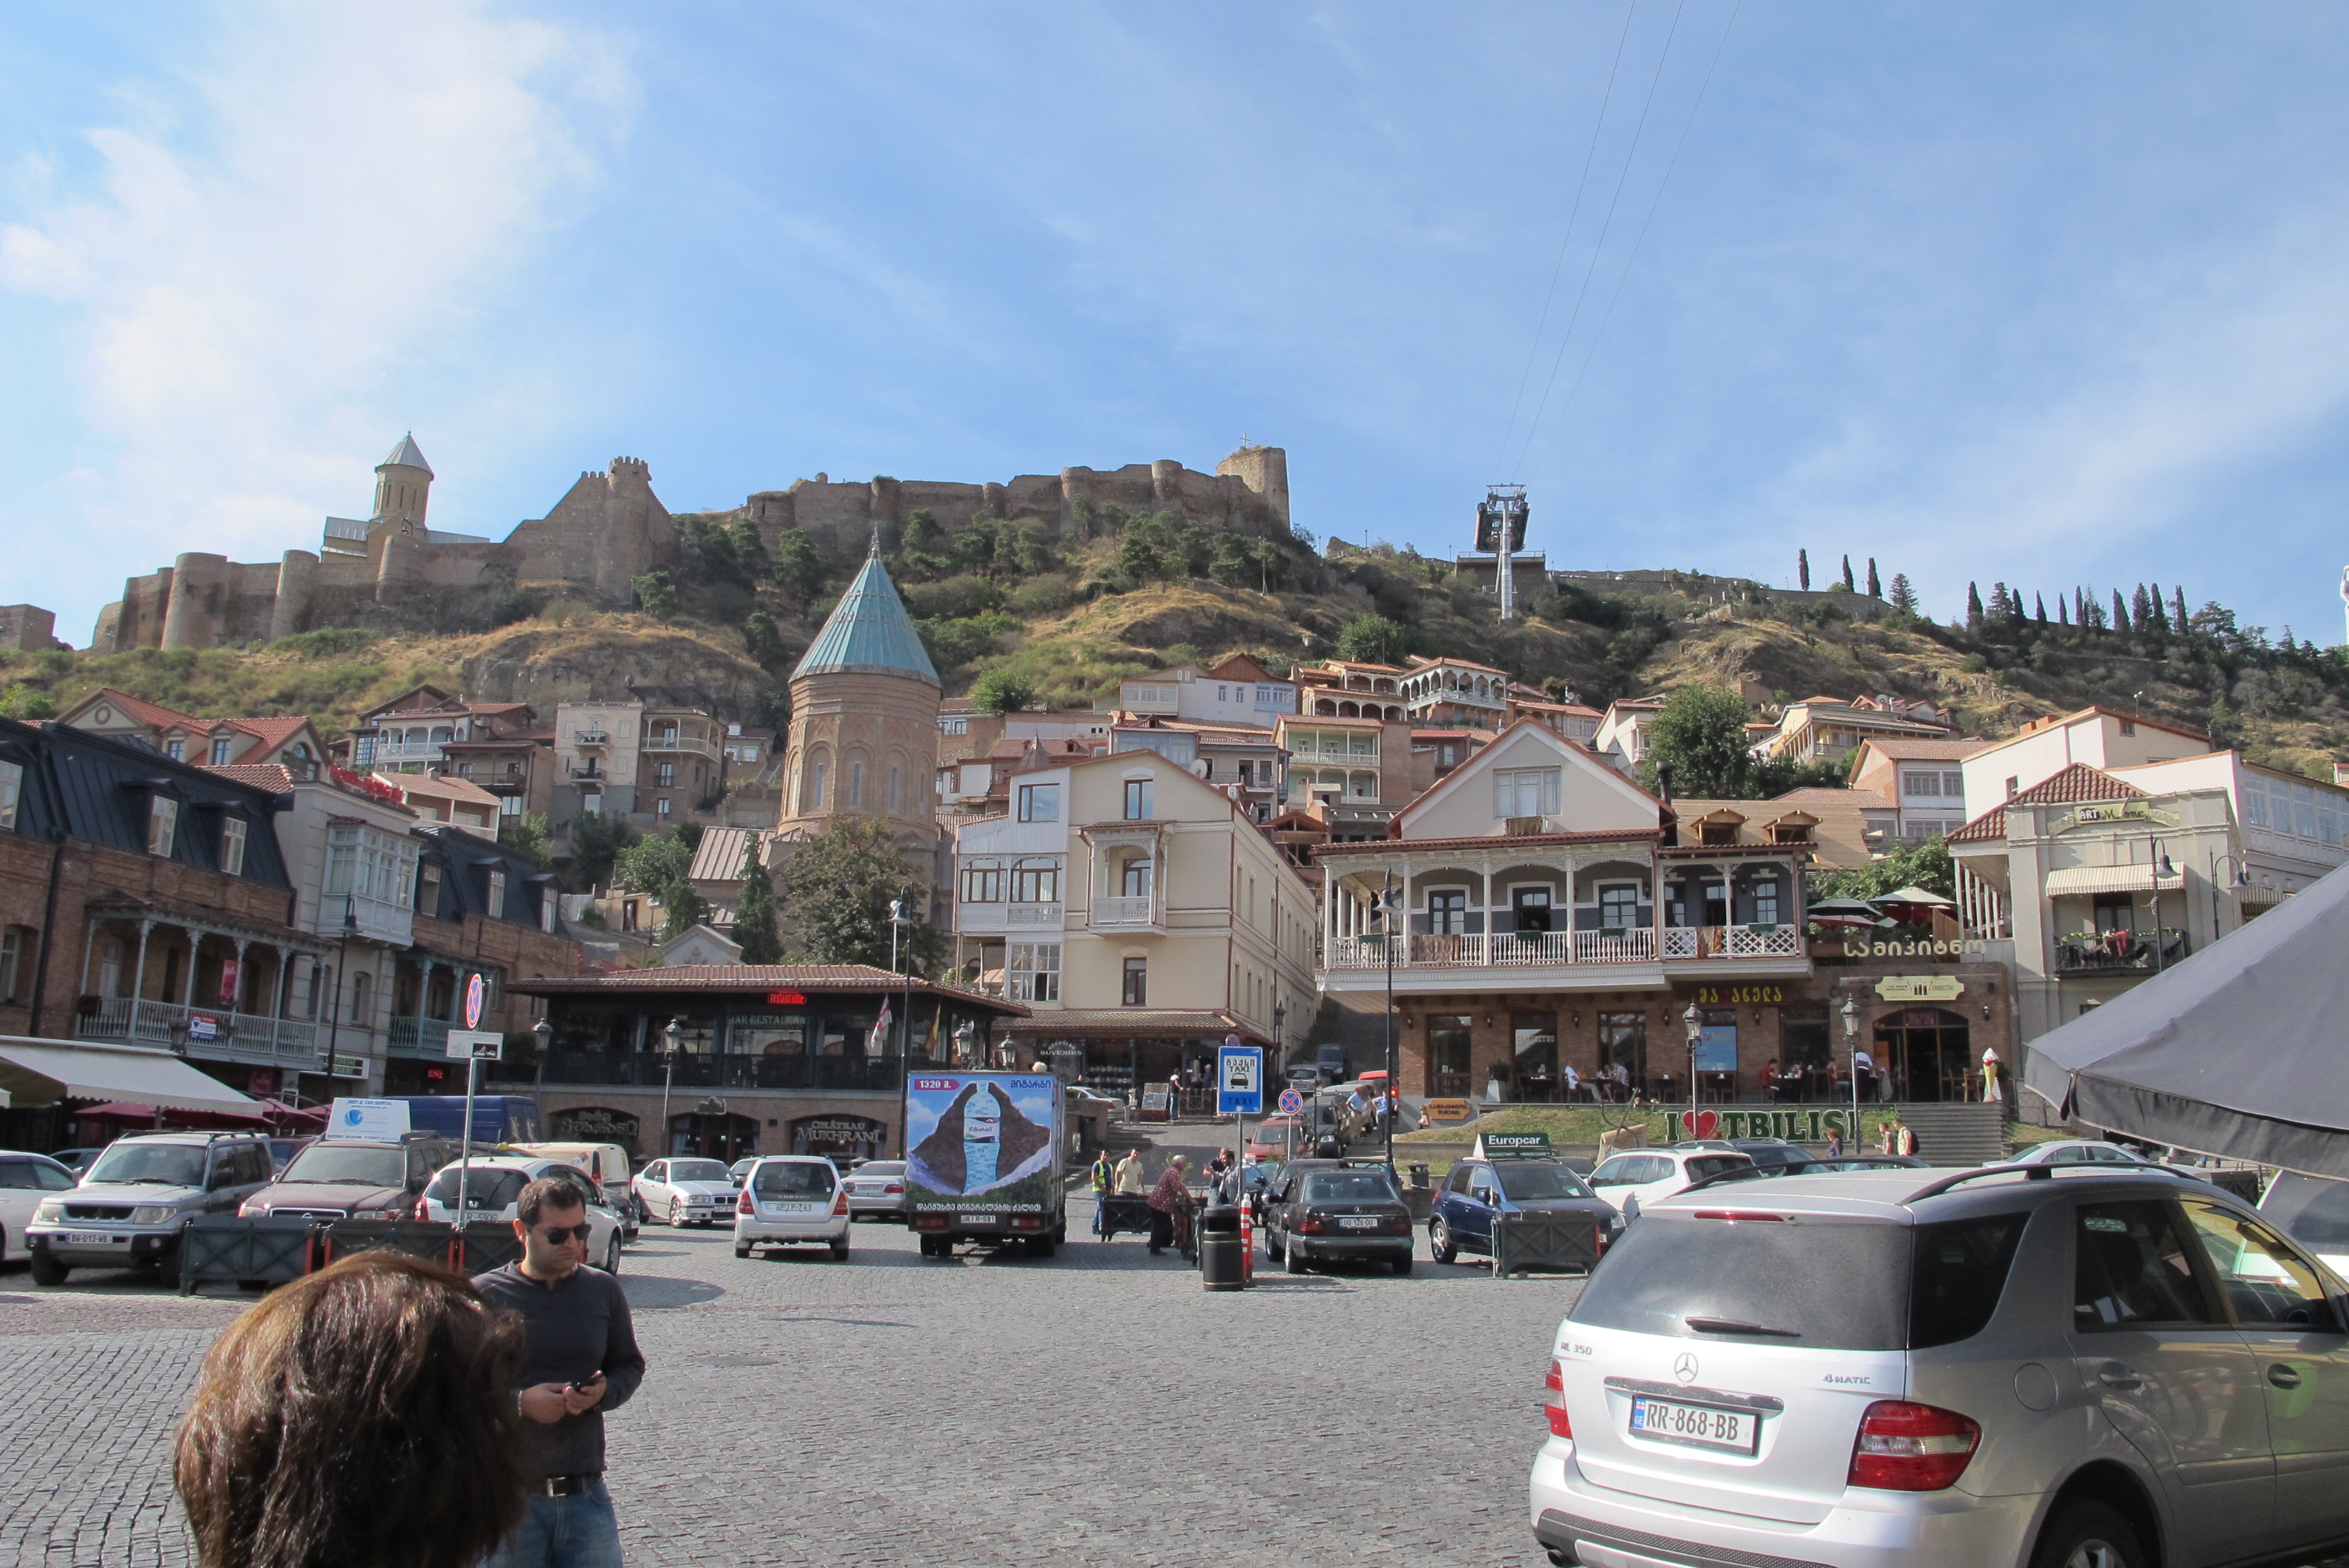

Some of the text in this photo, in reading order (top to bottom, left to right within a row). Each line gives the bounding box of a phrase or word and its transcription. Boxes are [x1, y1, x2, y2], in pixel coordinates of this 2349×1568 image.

[2080, 810, 2098, 820] ART
[1843, 940, 1986, 957] სამიკიტნო
[1699, 988, 1783, 1003] მაახელა
[1225, 1058, 1255, 1067] ტაქსი
[920, 1080, 941, 1088] 1320
[1665, 1109, 1861, 1142] I TBILISI
[795, 1128, 880, 1143] MUKHRANI
[1488, 1135, 1541, 1147] Europcar
[1573, 1344, 1592, 1355] 350
[1823, 1374, 1871, 1385] 4MATIC
[1633, 1415, 1644, 1425] GE
[1646, 1403, 1738, 1441] RR-868-BB
